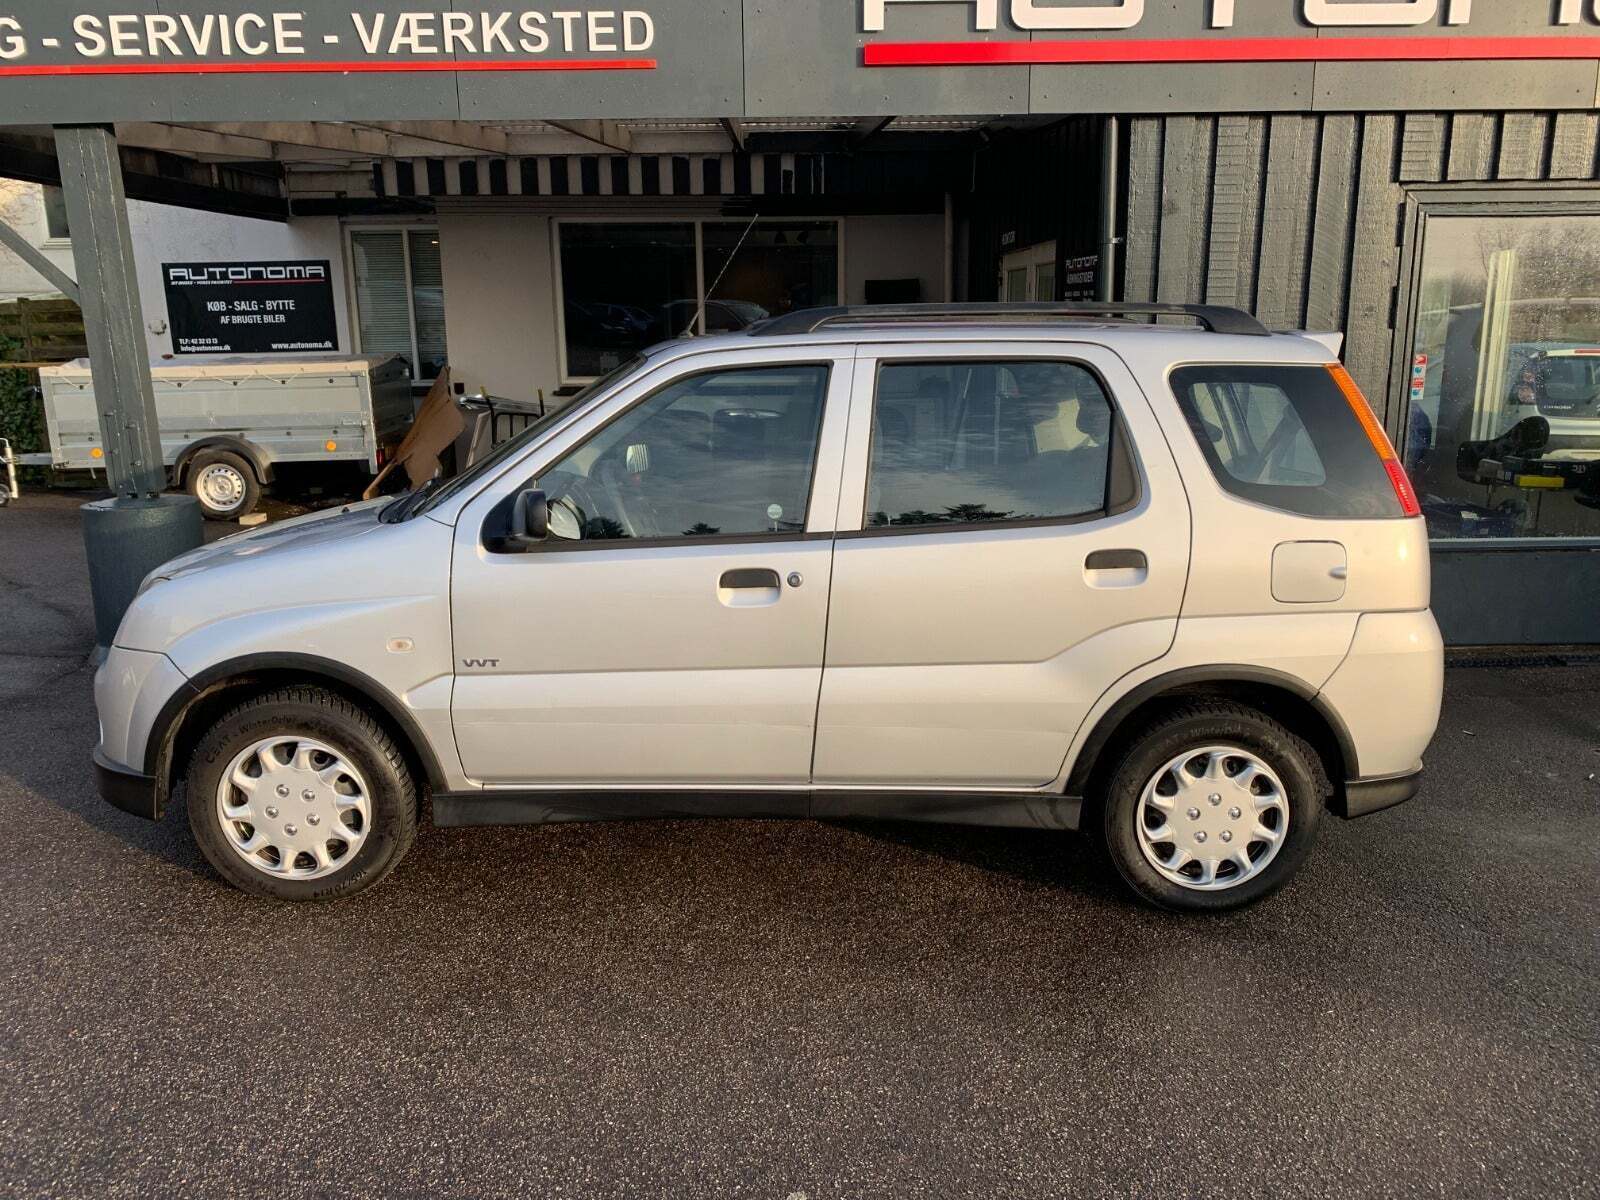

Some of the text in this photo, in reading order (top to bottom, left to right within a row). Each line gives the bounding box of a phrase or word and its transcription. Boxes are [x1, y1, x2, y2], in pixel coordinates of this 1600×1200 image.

[73, 12, 304, 57] SERVICE
[351, 10, 655, 54] VÆRKSTED
[169, 265, 325, 280] AUTONOMA
[207, 301, 226, 312] KØB
[233, 301, 258, 311] SALG
[266, 300, 296, 310] BYTTE
[220, 314, 286, 324] AF BRUGTE BILER
[271, 341, 333, 349] www.autonoma.dk
[462, 659, 500, 667] VVT
